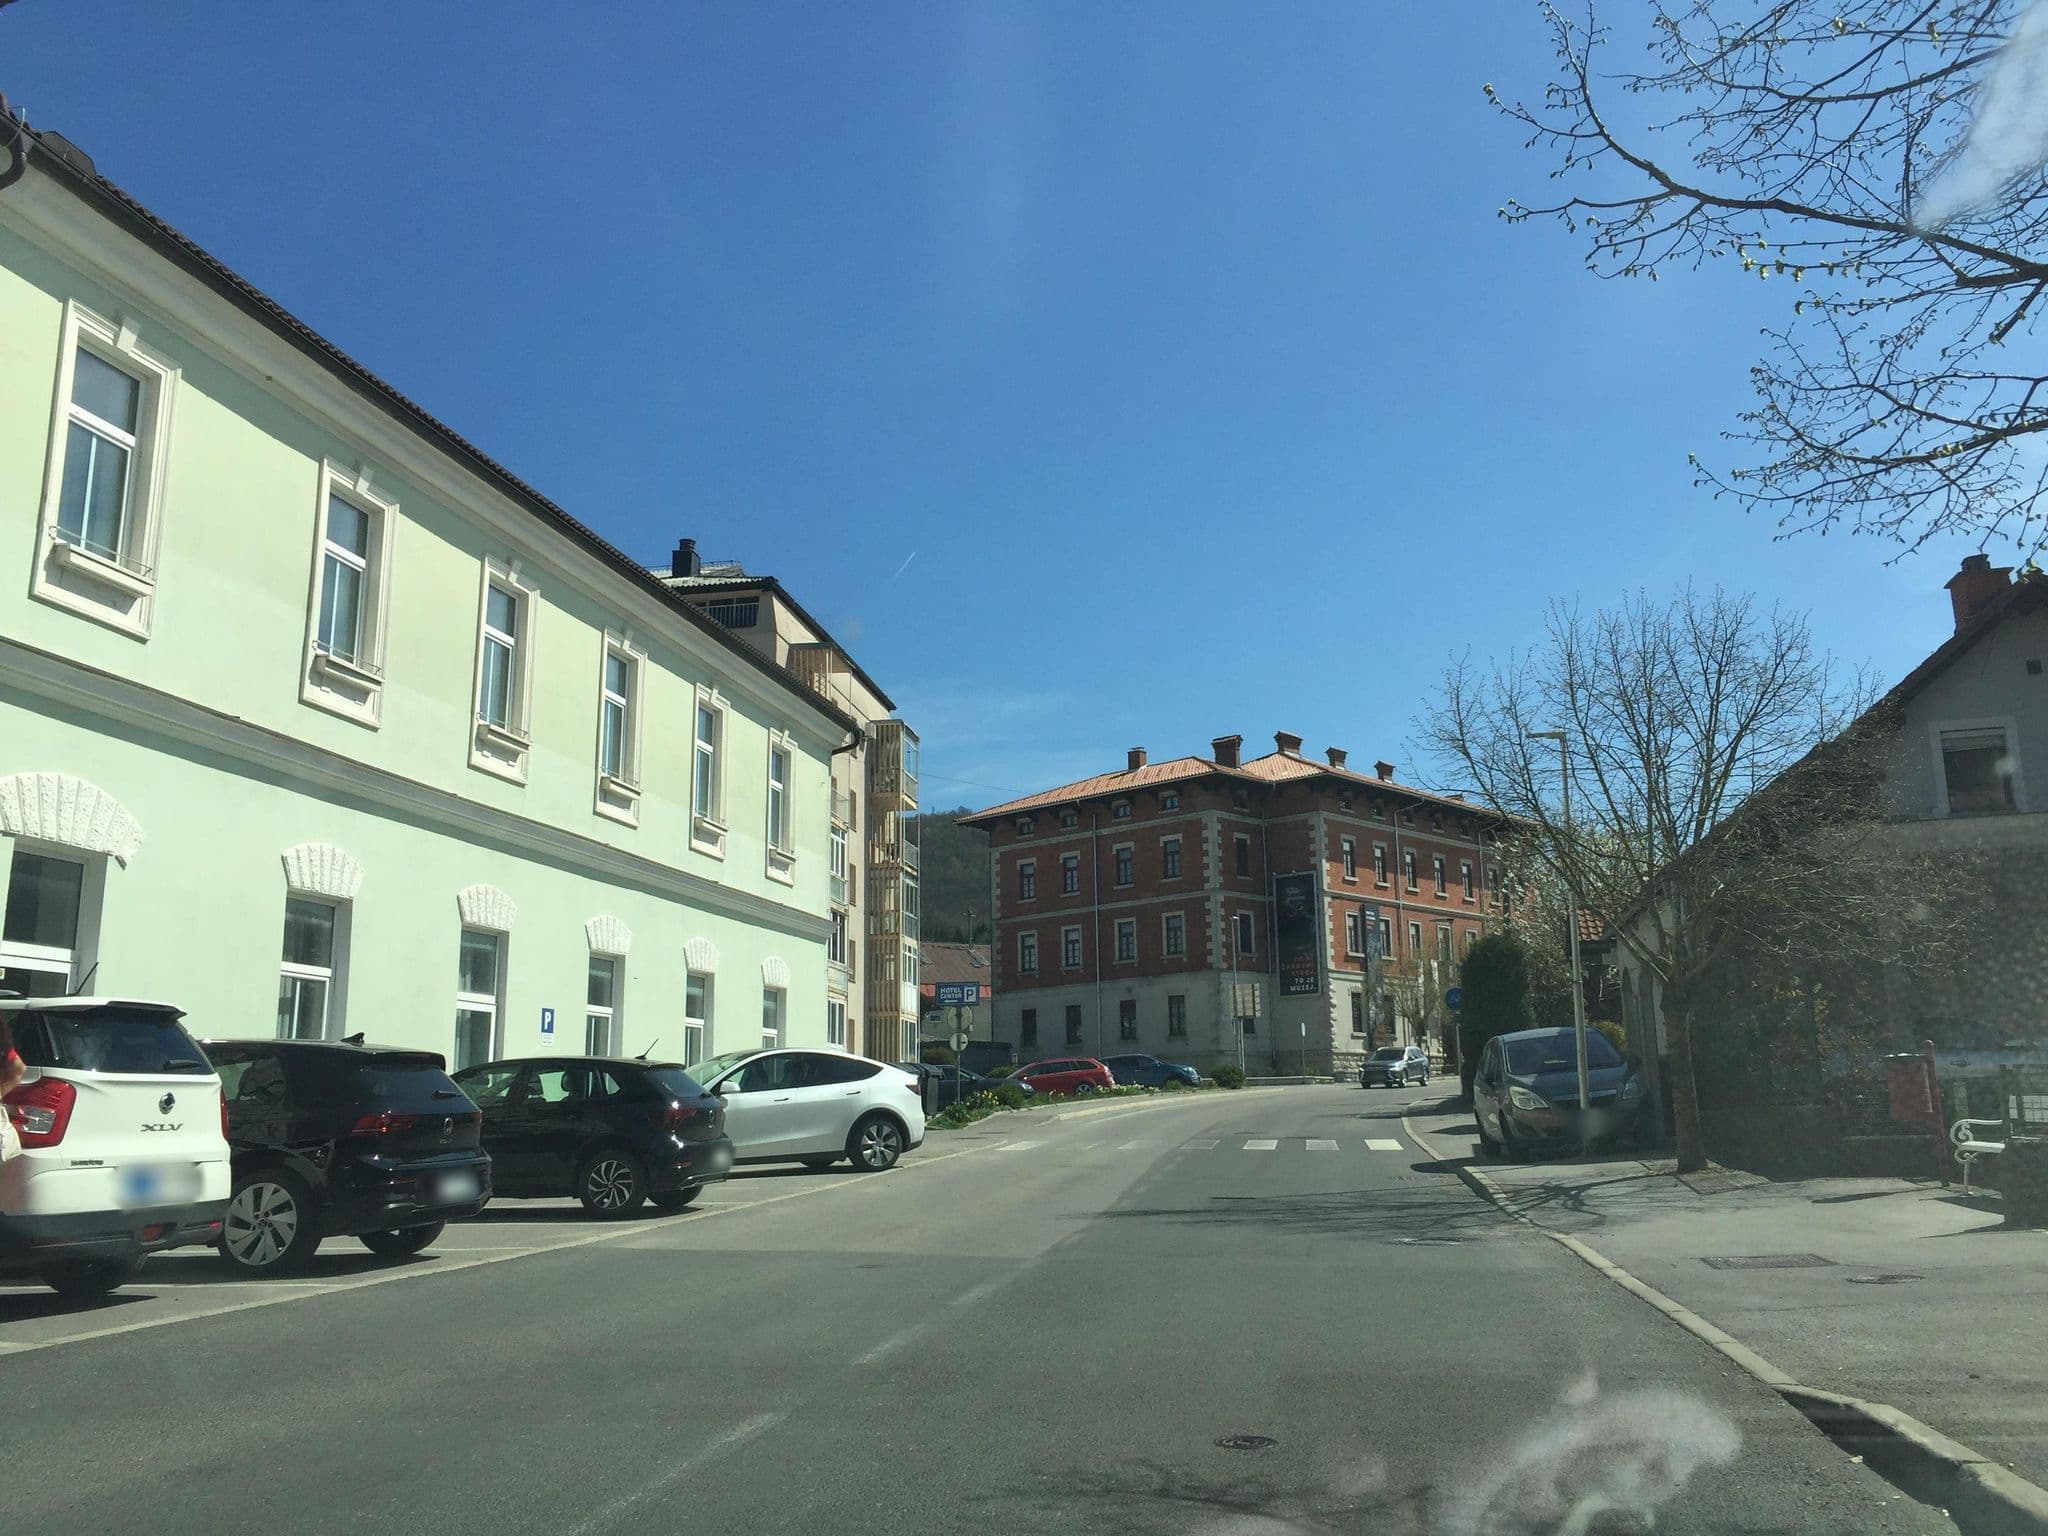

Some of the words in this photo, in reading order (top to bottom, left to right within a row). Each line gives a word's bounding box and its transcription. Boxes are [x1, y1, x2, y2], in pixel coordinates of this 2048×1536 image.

[966, 989, 974, 1000] P
[544, 1011, 552, 1030] P
[141, 1123, 184, 1132] XLV
